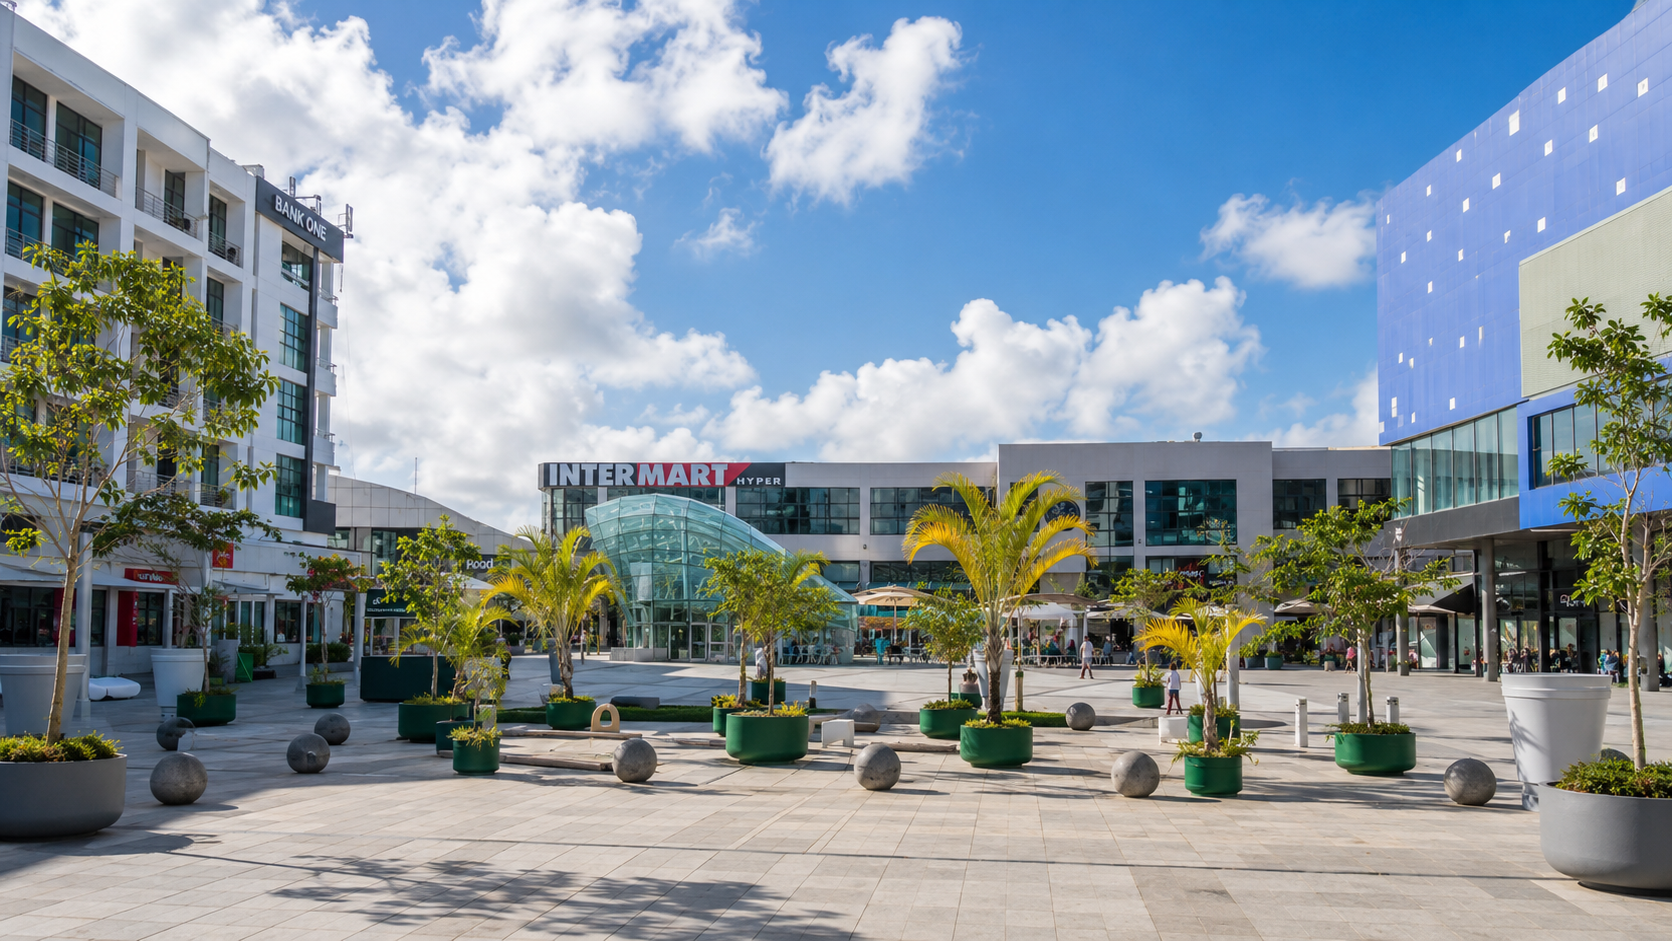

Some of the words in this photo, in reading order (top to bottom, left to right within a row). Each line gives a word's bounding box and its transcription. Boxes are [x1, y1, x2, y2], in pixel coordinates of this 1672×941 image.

[275, 194, 304, 228] BANK
[306, 216, 326, 241] ONE
[549, 463, 728, 486] INTERMART
[736, 477, 781, 486] HYPER
